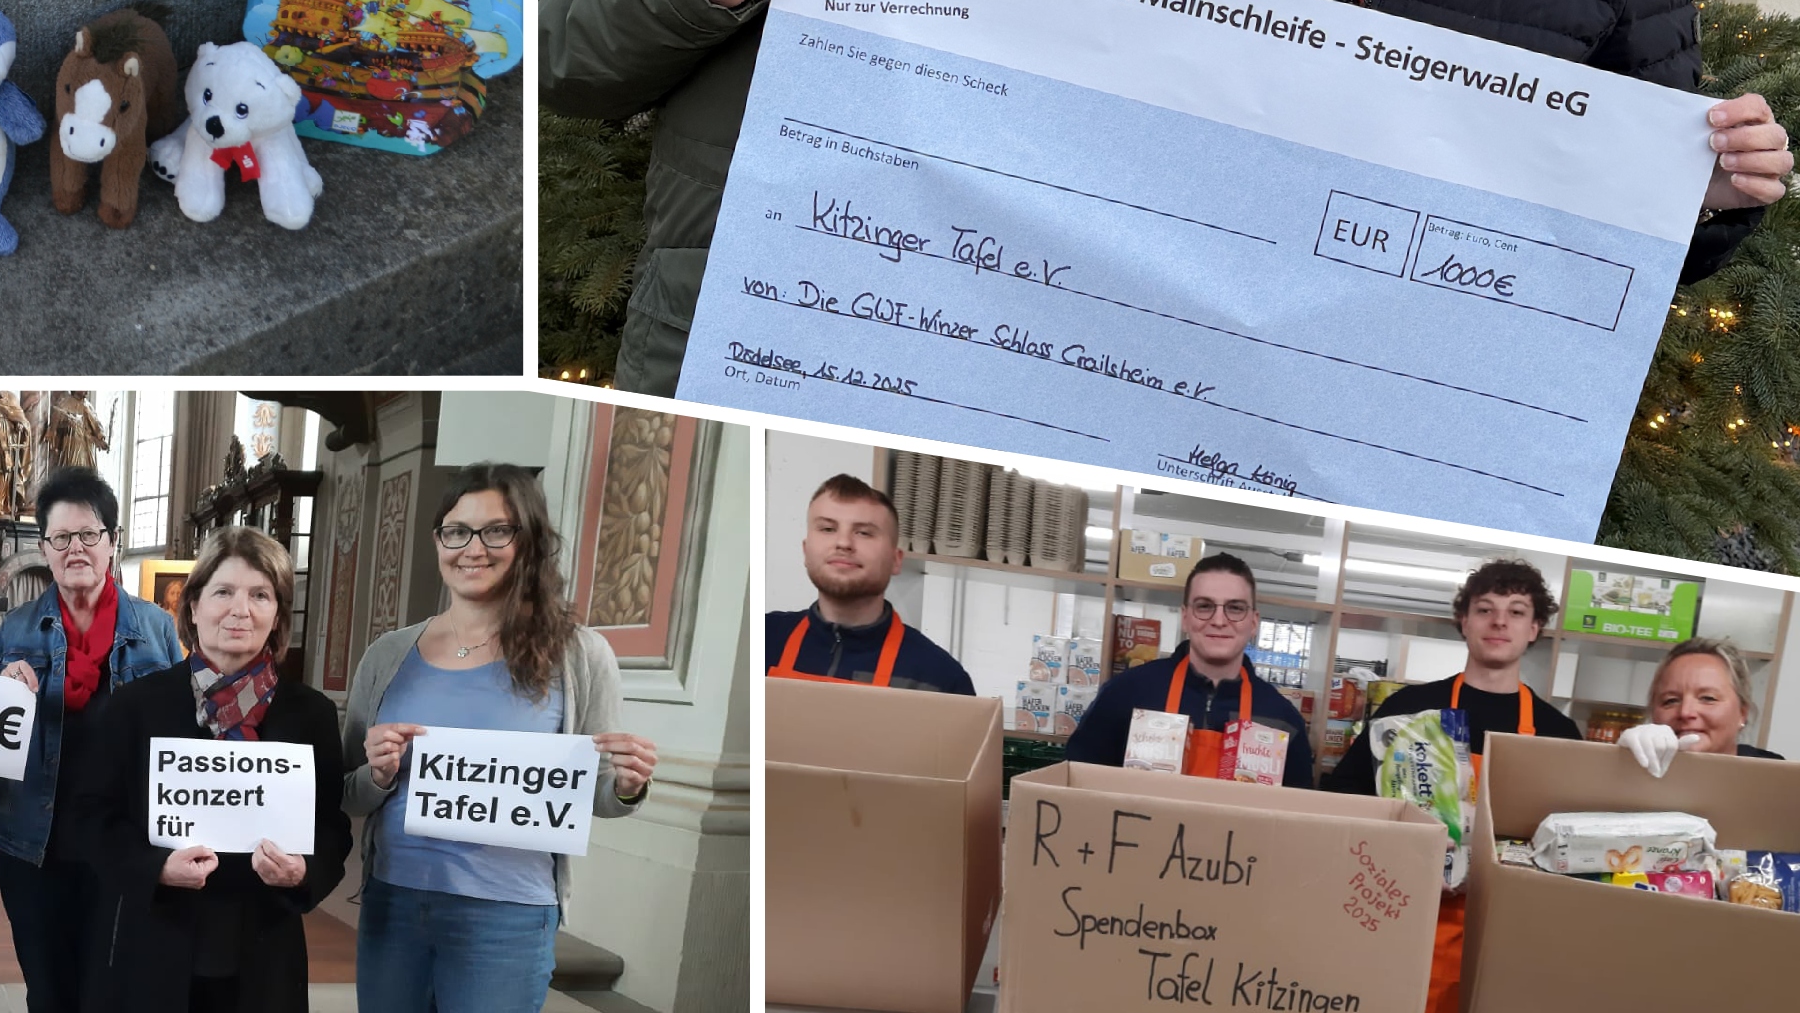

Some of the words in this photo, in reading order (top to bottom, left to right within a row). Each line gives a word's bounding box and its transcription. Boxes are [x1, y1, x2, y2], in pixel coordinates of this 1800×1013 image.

[854, 2, 877, 13] zur
[880, 1, 970, 19] Verrechnung
[798, 33, 845, 56] Zahlen
[846, 45, 868, 61] Sie
[869, 53, 911, 71] gegen
[914, 63, 959, 85] diesen
[961, 75, 1010, 97] Scheck
[1353, 34, 1541, 104] Steigerwald
[1545, 89, 1590, 118] eG
[779, 124, 823, 149] Betrag
[825, 136, 838, 150] in
[840, 141, 920, 171] Buchstaben
[765, 208, 782, 221] an
[810, 191, 930, 262] Kitzinger
[950, 224, 1004, 276] Tafel
[1013, 256, 1071, 288] e.V.
[1332, 218, 1390, 254] EUR
[1428, 222, 1464, 241] Betrag:
[1466, 231, 1491, 248] Euro,
[1494, 239, 1519, 253] Cent
[743, 276, 788, 301] von:
[798, 280, 840, 313] Die
[1060, 343, 1164, 390] Crailsheim
[724, 365, 751, 384] Ort,
[755, 372, 801, 391] Datum
[813, 361, 919, 396] 15.12.2025
[1188, 443, 1240, 480] Helga
[1118, 638, 1134, 649] TO
[1602, 623, 1654, 637] BIO-TEE
[157, 750, 302, 775] Passions-
[419, 751, 588, 794] Kitzinger
[1414, 741, 1434, 798] kokett
[156, 782, 265, 808] konzert
[414, 791, 498, 824] Tafel
[510, 800, 577, 830] e.V.
[156, 815, 195, 839] für
[1032, 799, 1062, 868] R
[1077, 842, 1095, 865] +
[1108, 809, 1153, 874] F
[1159, 822, 1259, 886] Azubi
[1349, 841, 1412, 908] Soziales
[1342, 896, 1381, 933] 2025
[1348, 872, 1402, 921] Projekt
[1052, 885, 1219, 950] Spendenbox
[1138, 947, 1215, 1006] Tafel
[1230, 961, 1361, 1013] Kitzingen
